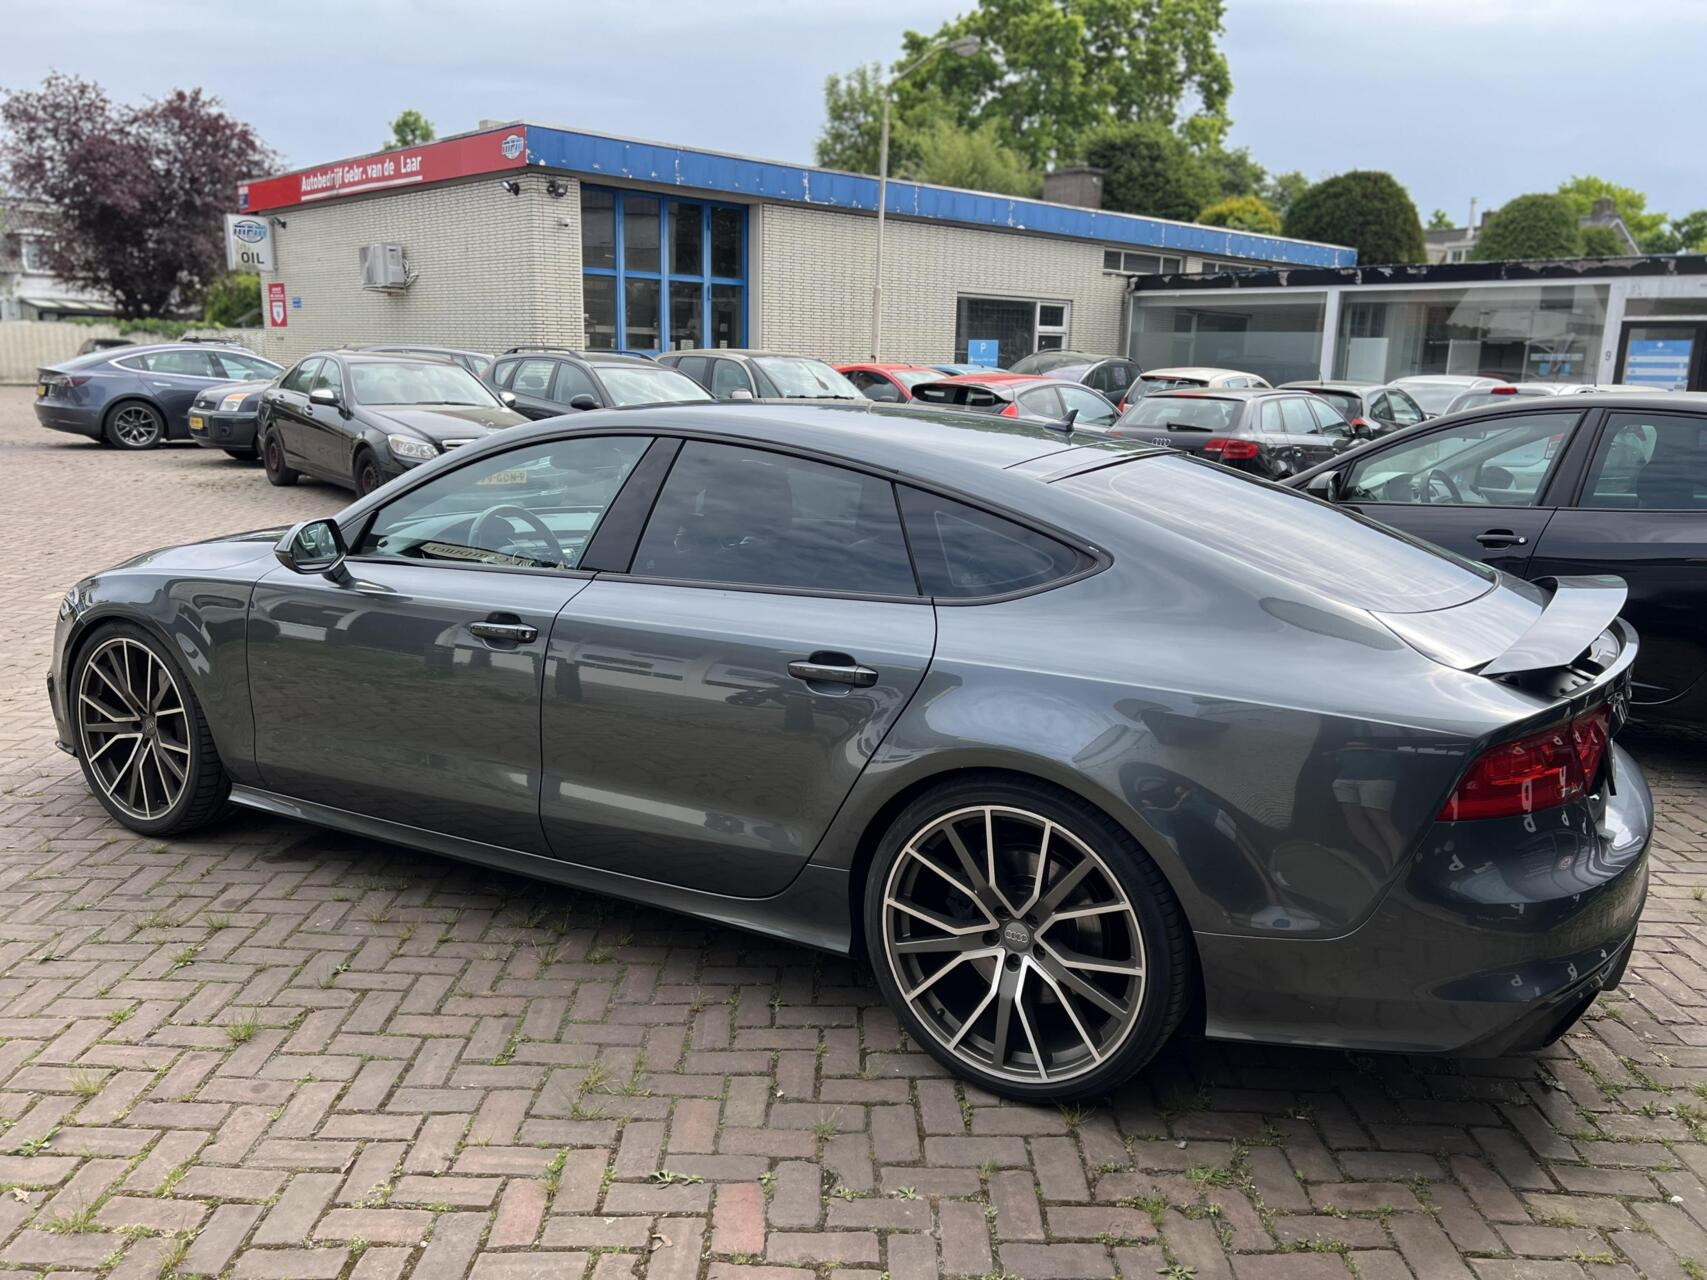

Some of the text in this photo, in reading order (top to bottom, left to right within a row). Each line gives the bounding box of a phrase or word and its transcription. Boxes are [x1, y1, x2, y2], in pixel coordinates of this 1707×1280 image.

[301, 155, 422, 192] Autobedrijf Gebr. van de Laar
[241, 252, 265, 264] OIL
